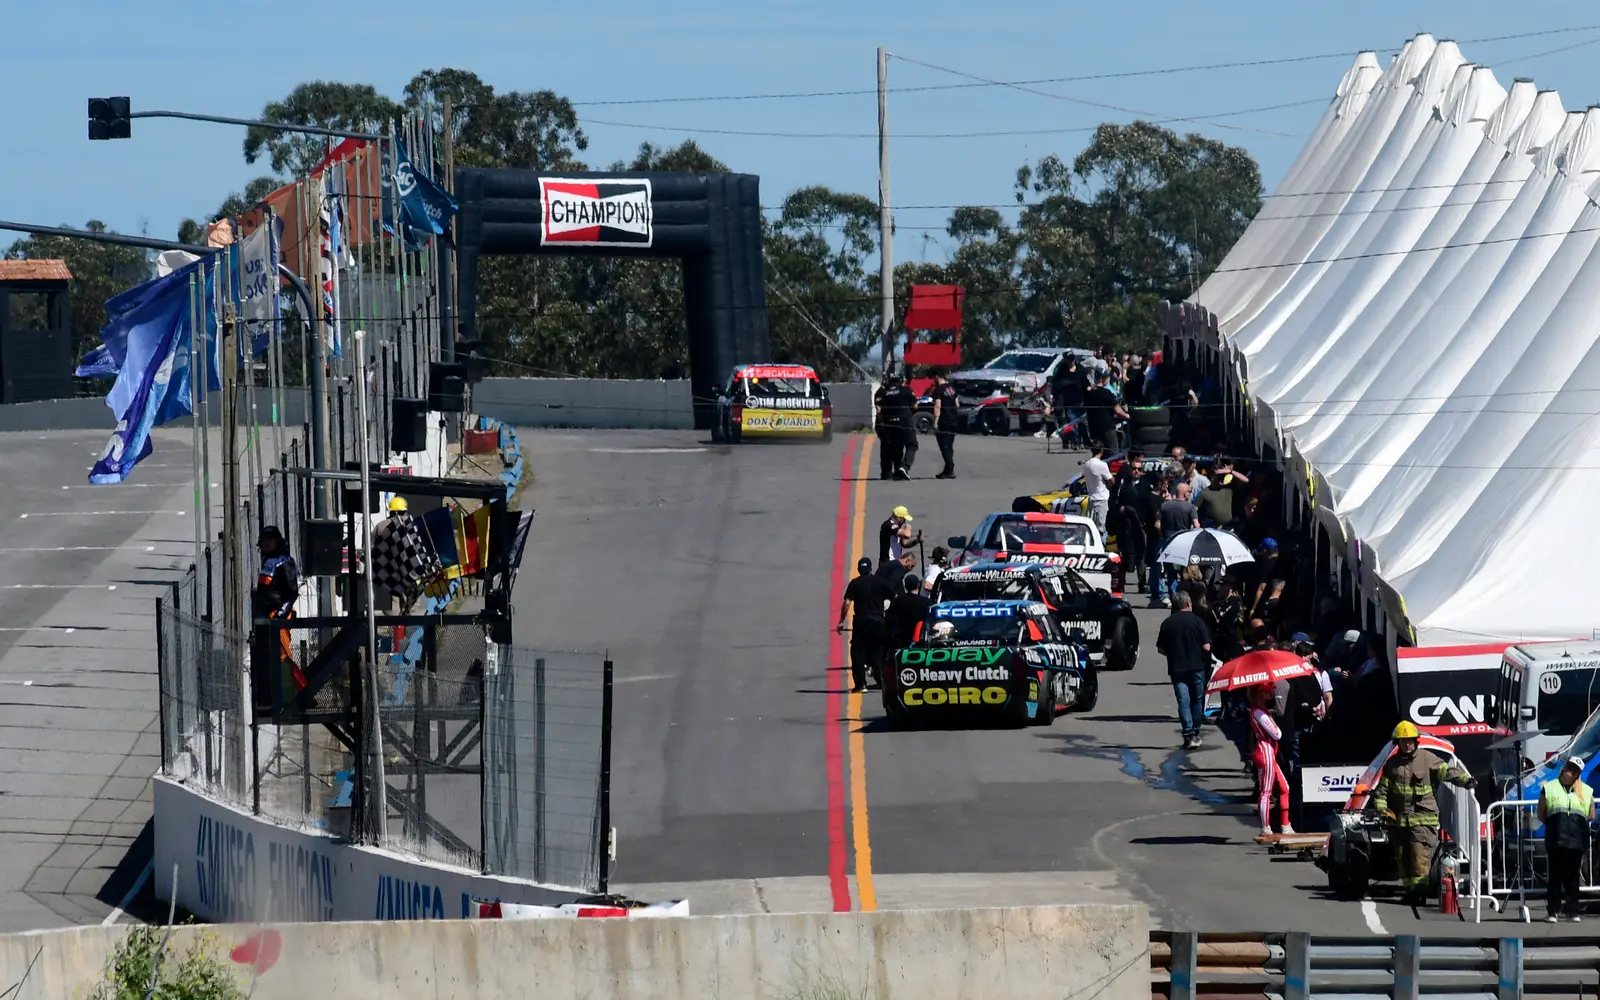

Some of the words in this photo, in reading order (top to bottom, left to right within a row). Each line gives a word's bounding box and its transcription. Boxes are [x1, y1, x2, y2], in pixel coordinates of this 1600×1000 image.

[551, 200, 646, 224] CHAMPION
[759, 397, 774, 408] TIM
[776, 398, 820, 409] ARGENTINA
[747, 417, 768, 426] DON
[937, 607, 1011, 617] FOTON
[901, 648, 1006, 666] bplay
[920, 668, 962, 684] Heavy
[965, 665, 1009, 680] Clutch
[1232, 671, 1269, 686] NAHUEL
[1543, 677, 1558, 689] 110
[903, 686, 1007, 706] COIRO
[1409, 694, 1496, 725] CAN
